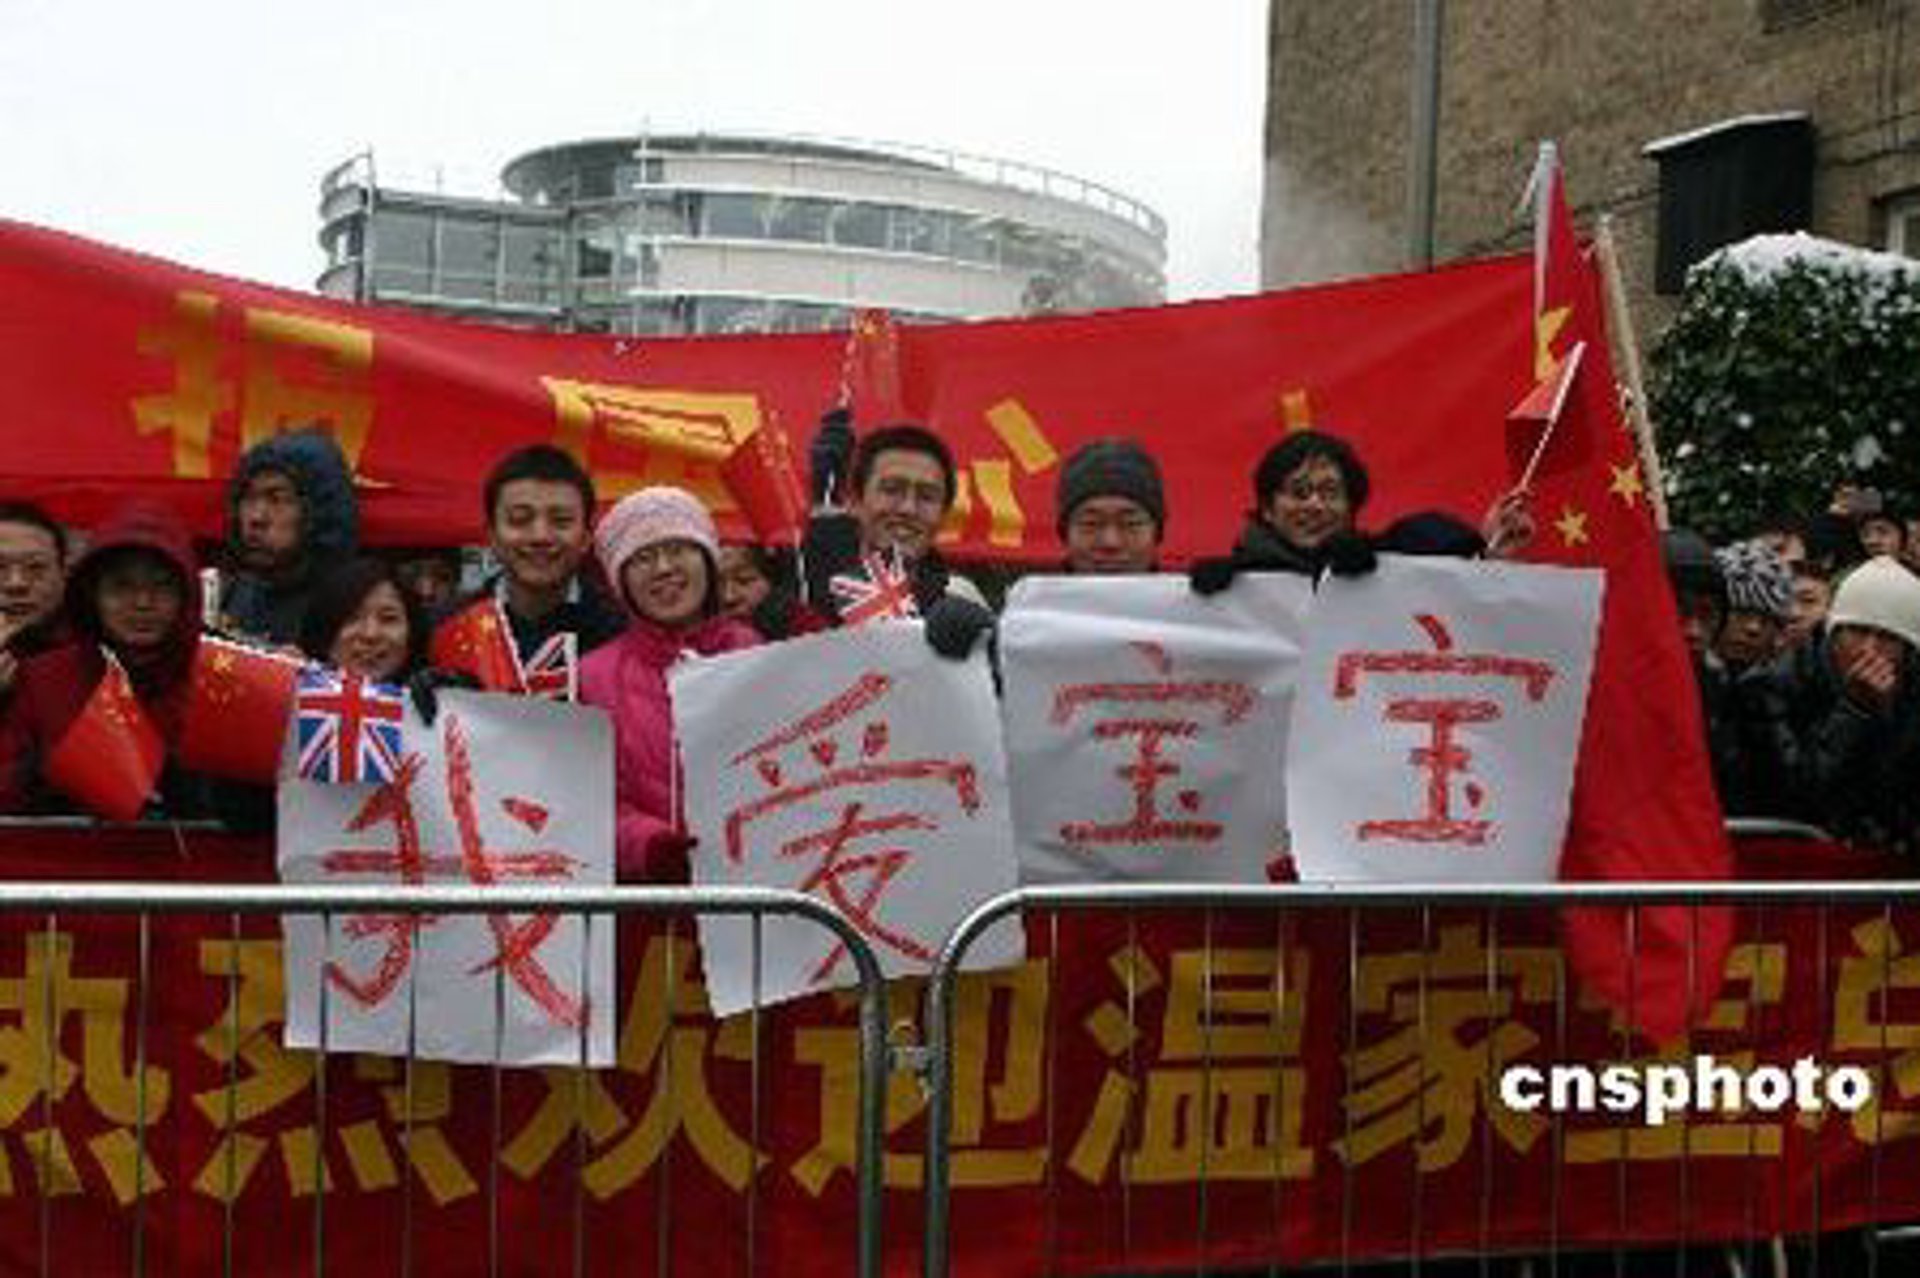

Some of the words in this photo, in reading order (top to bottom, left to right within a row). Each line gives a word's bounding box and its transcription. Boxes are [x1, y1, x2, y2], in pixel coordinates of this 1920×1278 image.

[725, 672, 981, 986] 爱
[1050, 640, 1258, 845] 宝
[1334, 613, 1555, 847] 宝
[322, 711, 592, 1030] 我
